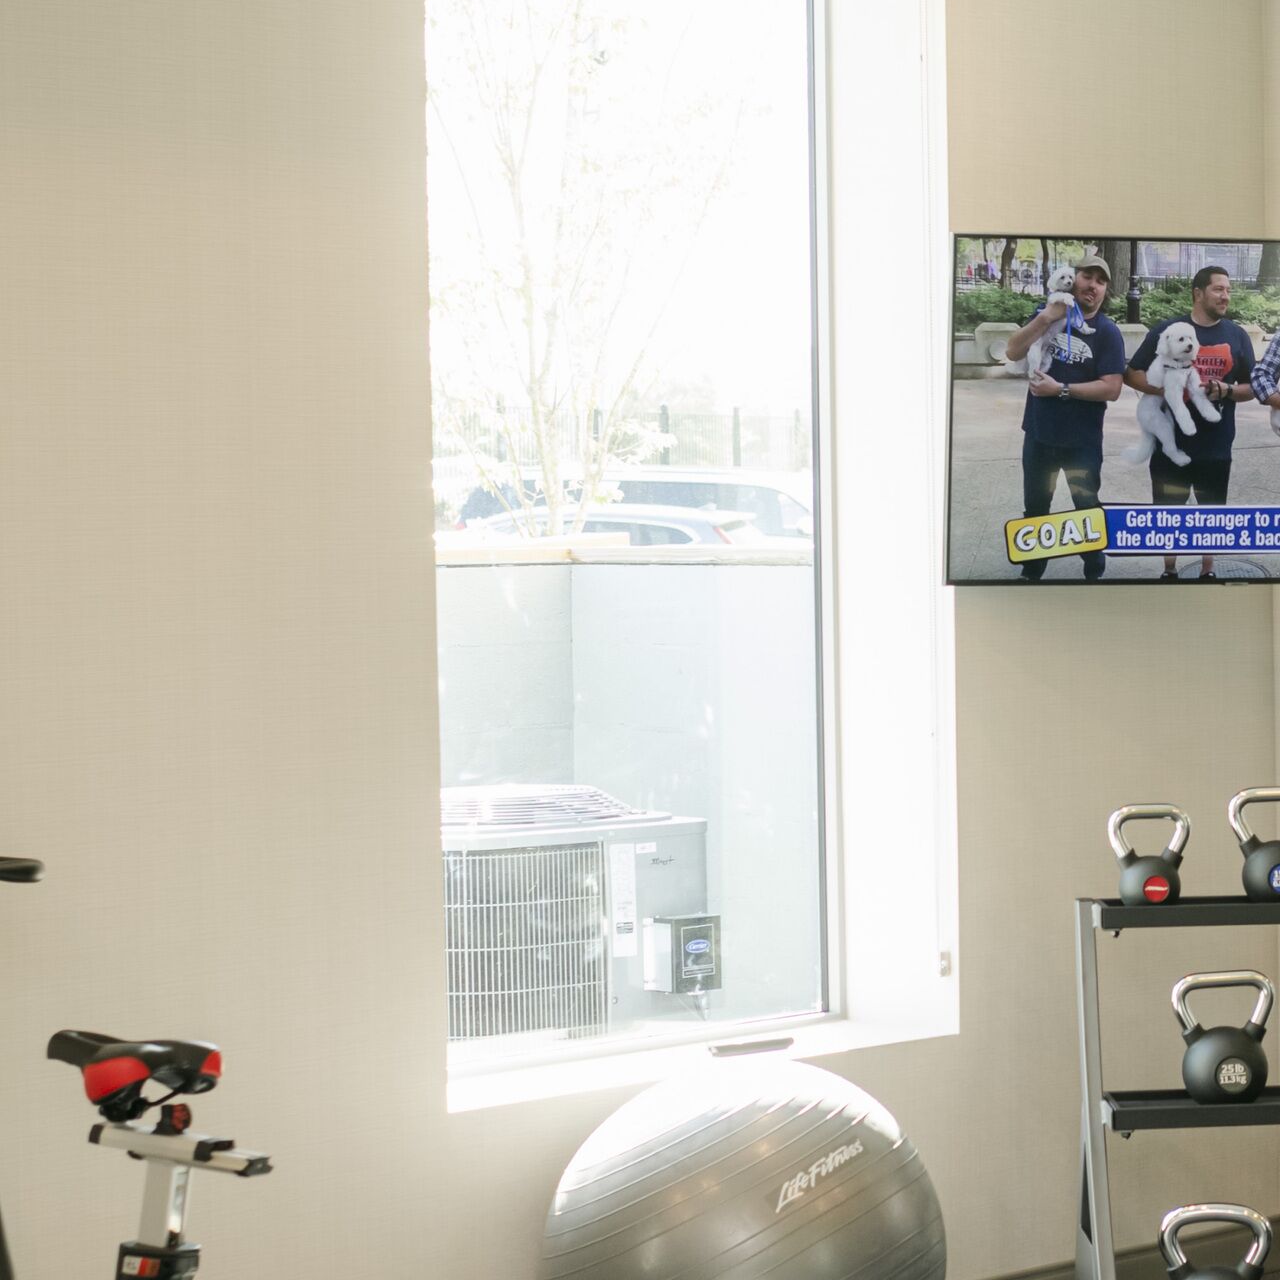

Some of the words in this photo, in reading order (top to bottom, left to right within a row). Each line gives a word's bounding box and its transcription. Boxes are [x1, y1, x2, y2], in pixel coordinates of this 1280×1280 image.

[1126, 511, 1152, 527] Get
[1156, 511, 1182, 527] the
[1185, 511, 1250, 530] stranger
[1254, 512, 1269, 527] to
[1015, 516, 1101, 551] GOAL
[1116, 531, 1142, 546] the
[1145, 530, 1188, 550] dog's
[1192, 534, 1234, 547] name
[1238, 531, 1251, 546] &
[1221, 1063, 1235, 1074] 25
[1235, 1063, 1245, 1073] lb
[1220, 1075, 1236, 1085] 11.3
[1236, 1074, 1248, 1085] kg
